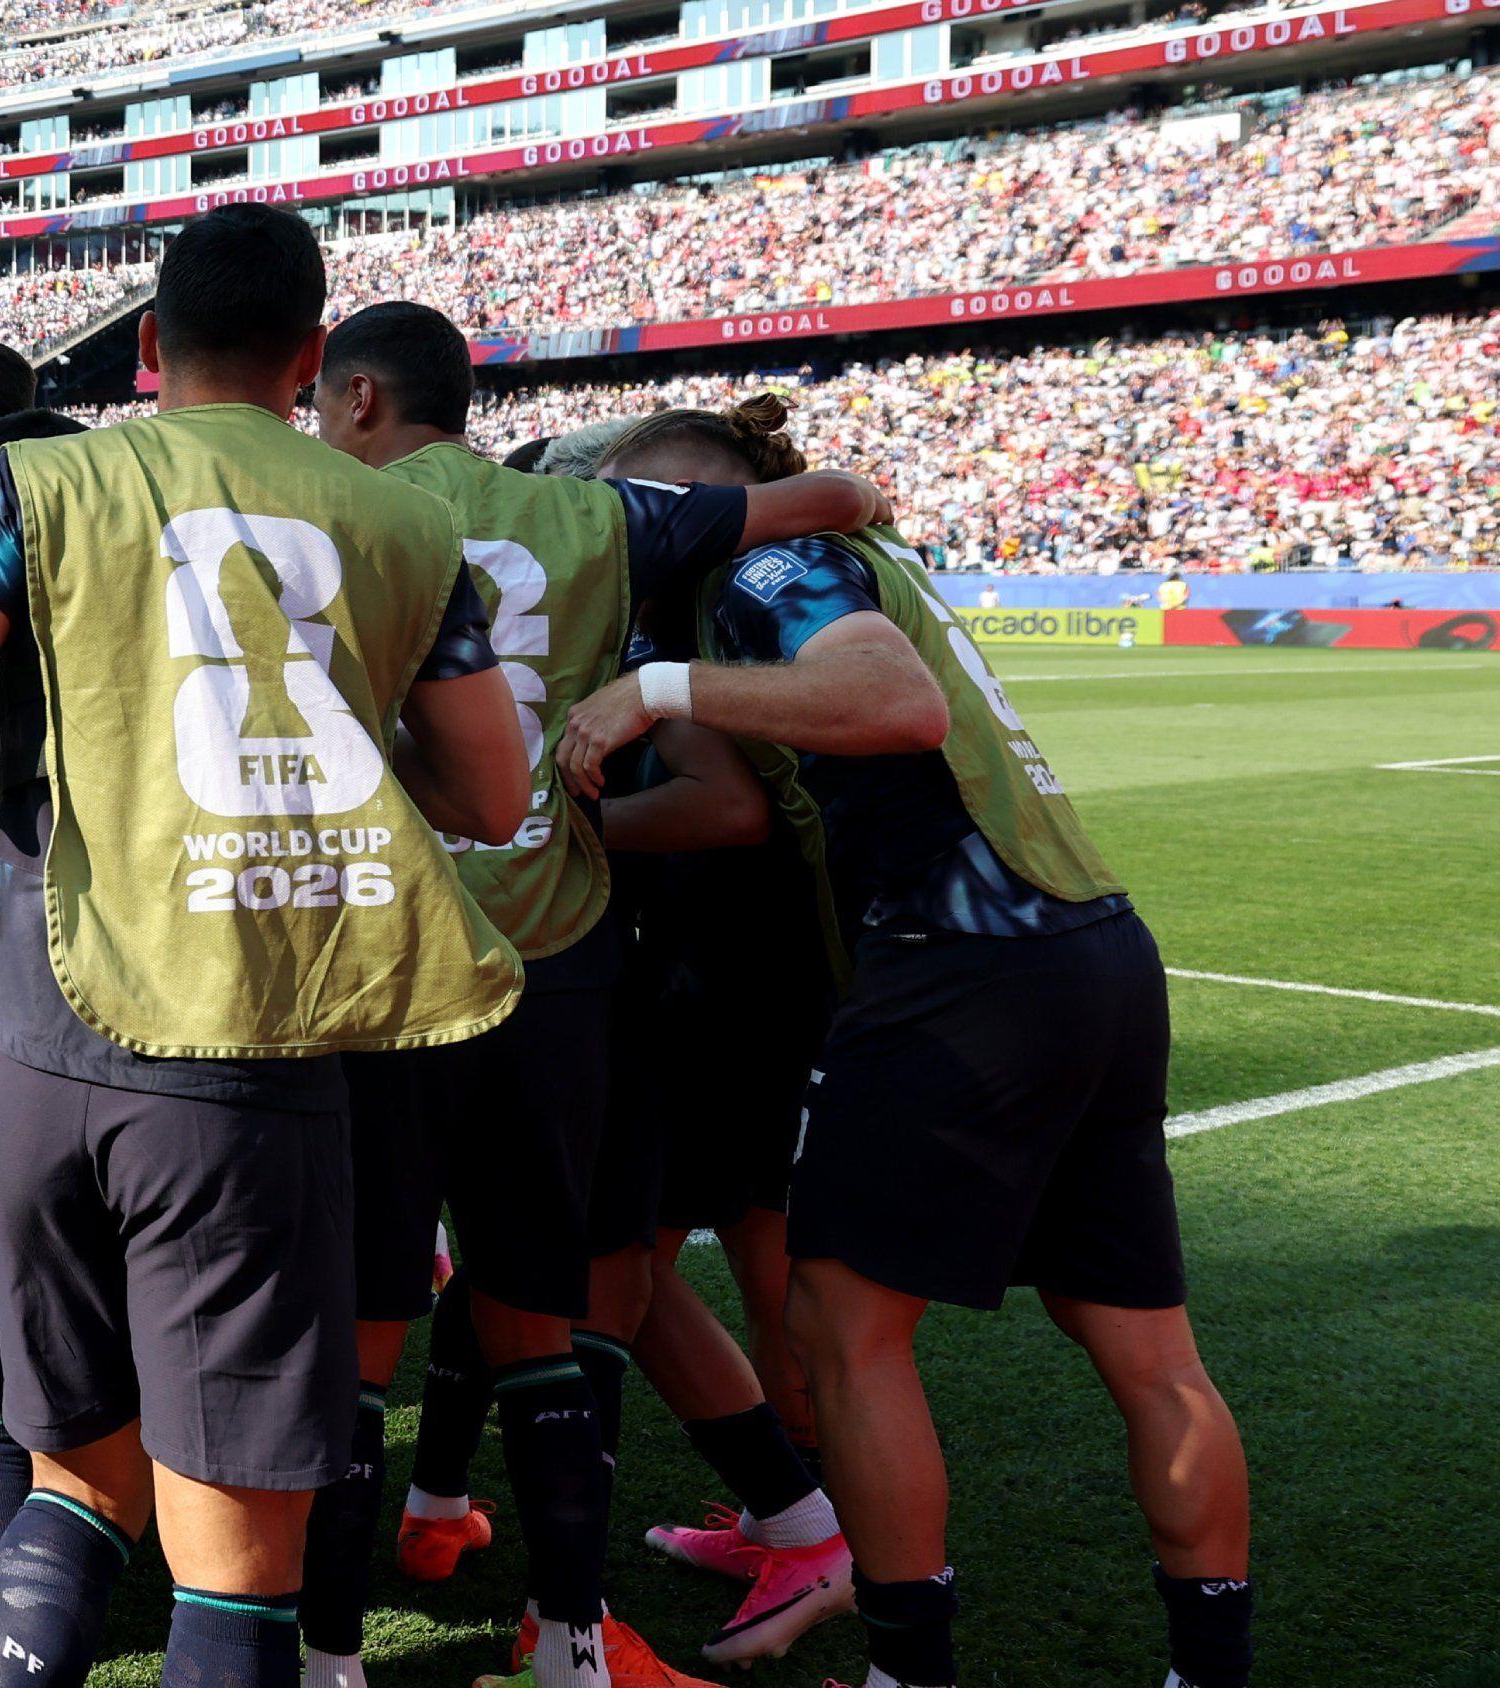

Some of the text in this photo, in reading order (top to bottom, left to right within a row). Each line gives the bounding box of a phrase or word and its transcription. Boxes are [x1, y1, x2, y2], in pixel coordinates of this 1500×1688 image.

[1164, 10, 1357, 65] GOOOAL
[521, 55, 653, 96] GOOOAL
[921, 57, 1091, 104] GOOOAL
[351, 88, 470, 123] GOOOAL
[194, 116, 304, 149] GOOOAL
[522, 129, 653, 167] GOOOAL
[352, 158, 470, 191] GOOOAL
[195, 182, 304, 213] GOOOAL
[1215, 257, 1361, 290] GOOOAL
[951, 288, 1075, 317] GOOOAL
[721, 314, 830, 339] GOOOAL
[1067, 610, 1138, 637] libre
[238, 754, 329, 786] FIFA
[183, 827, 392, 861] WORLD CUP
[185, 862, 396, 913] 2026
[344, 1463, 374, 1479] PF
